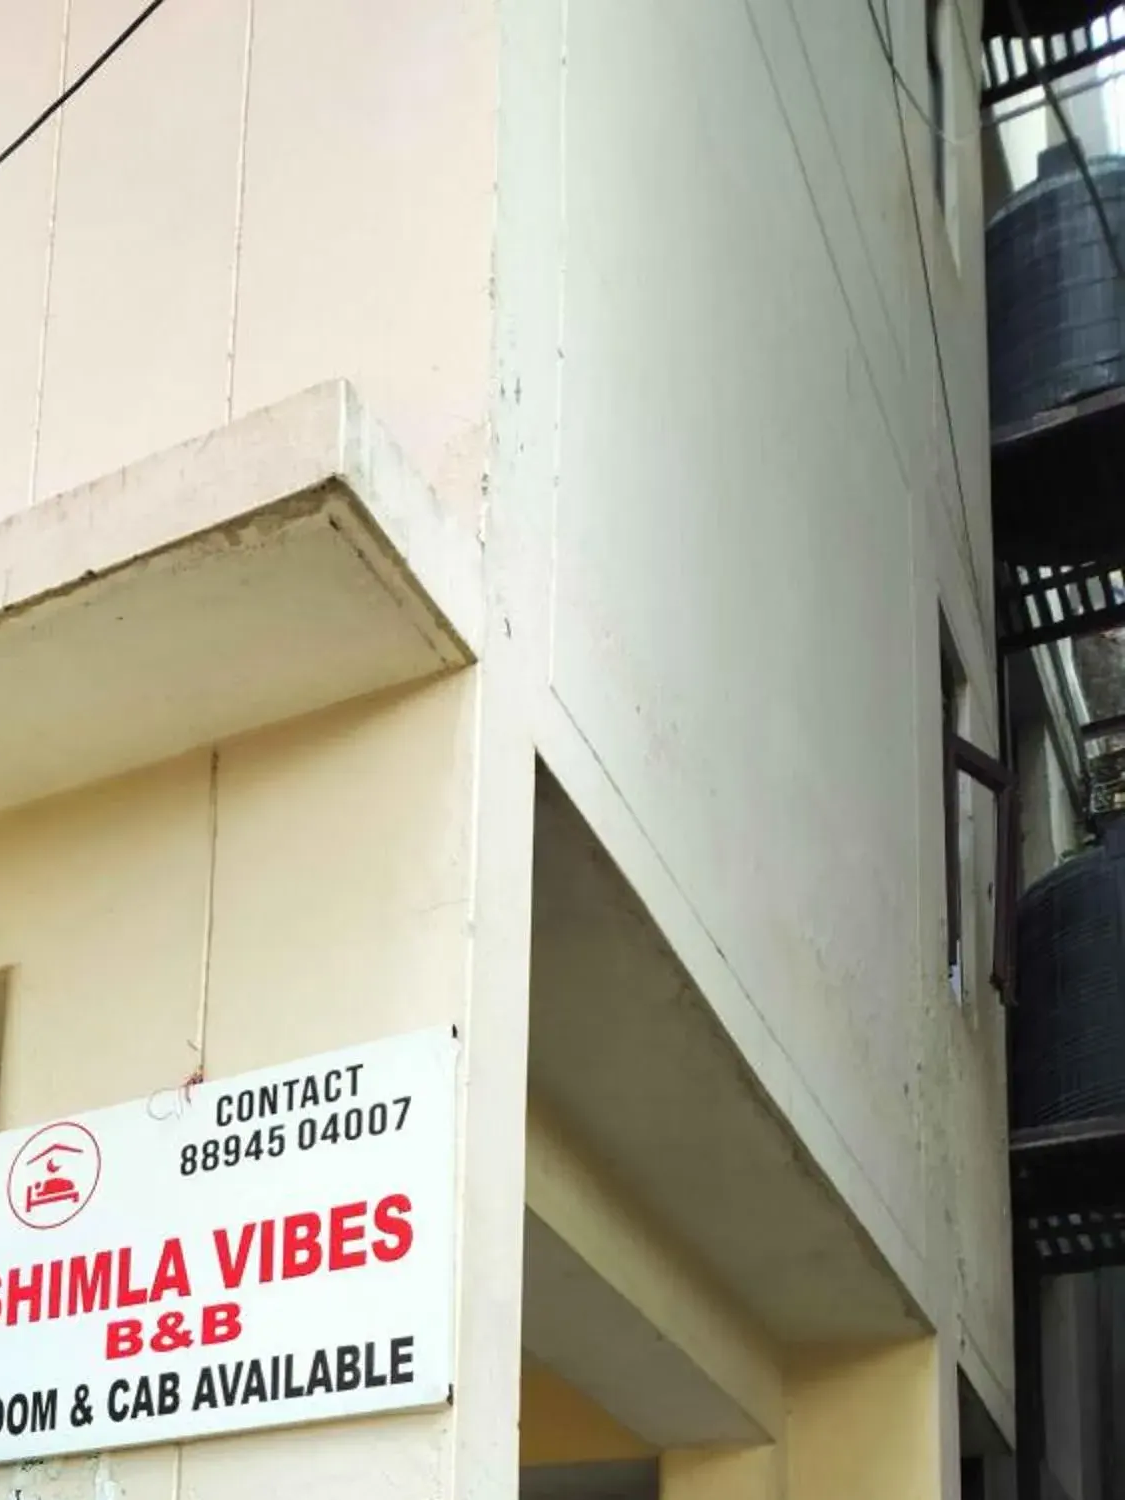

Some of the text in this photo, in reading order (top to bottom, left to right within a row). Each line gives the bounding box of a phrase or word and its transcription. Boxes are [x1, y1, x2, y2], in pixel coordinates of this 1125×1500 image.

[216, 1063, 364, 1127] CONTACT
[180, 1096, 412, 1176] 88945 04007
[212, 1193, 414, 1290] VIBES
[105, 1302, 242, 1361] B&B
[69, 1383, 94, 1428] &
[107, 1371, 180, 1423] CAB
[191, 1335, 414, 1412] AVAILABLE
